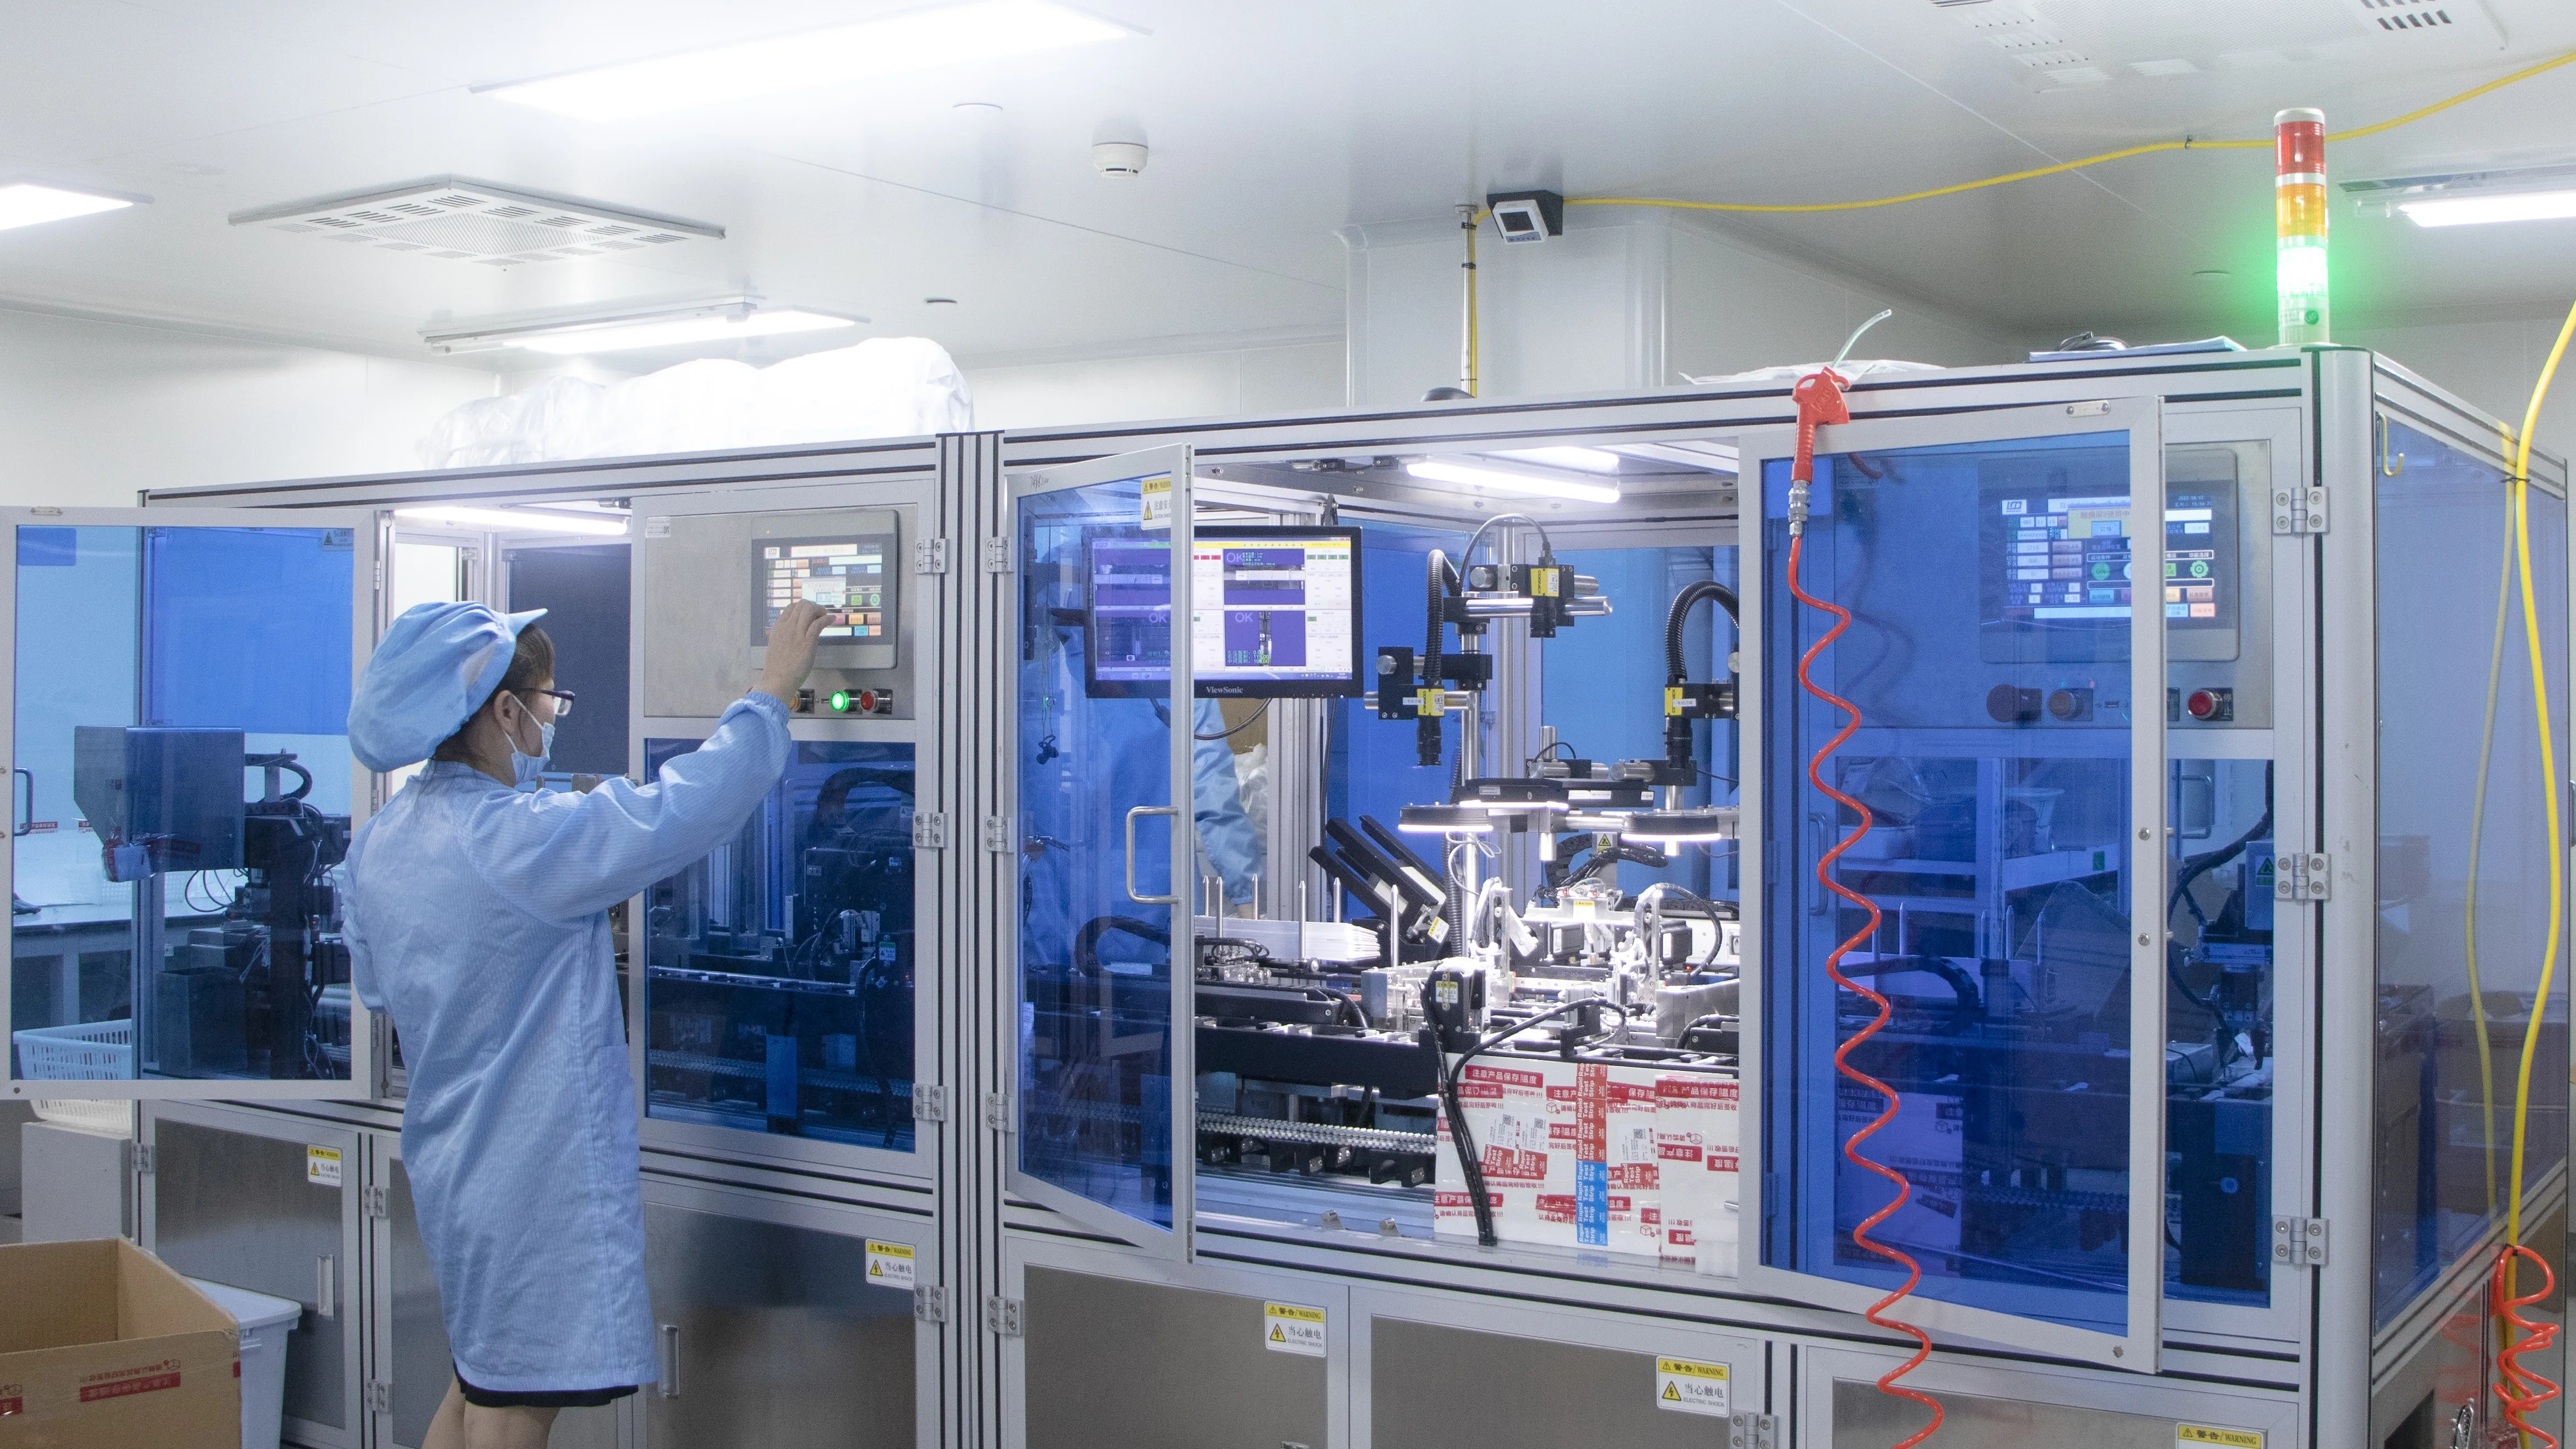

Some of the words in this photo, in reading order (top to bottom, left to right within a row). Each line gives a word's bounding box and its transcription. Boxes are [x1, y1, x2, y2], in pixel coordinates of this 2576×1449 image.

[1226, 552, 1243, 562] OK
[1149, 613, 1167, 623] OK
[1235, 612, 1254, 622] OK
[1472, 1068, 1537, 1085] 注意产品保存温度
[1658, 1146, 1694, 1158] 注意产品
[885, 1261, 912, 1274] 当心触电
[1289, 1325, 1321, 1339] 当心触电
[1685, 1383, 1724, 1398] 当心触电
[1683, 1397, 1706, 1405] ELECTRIC
